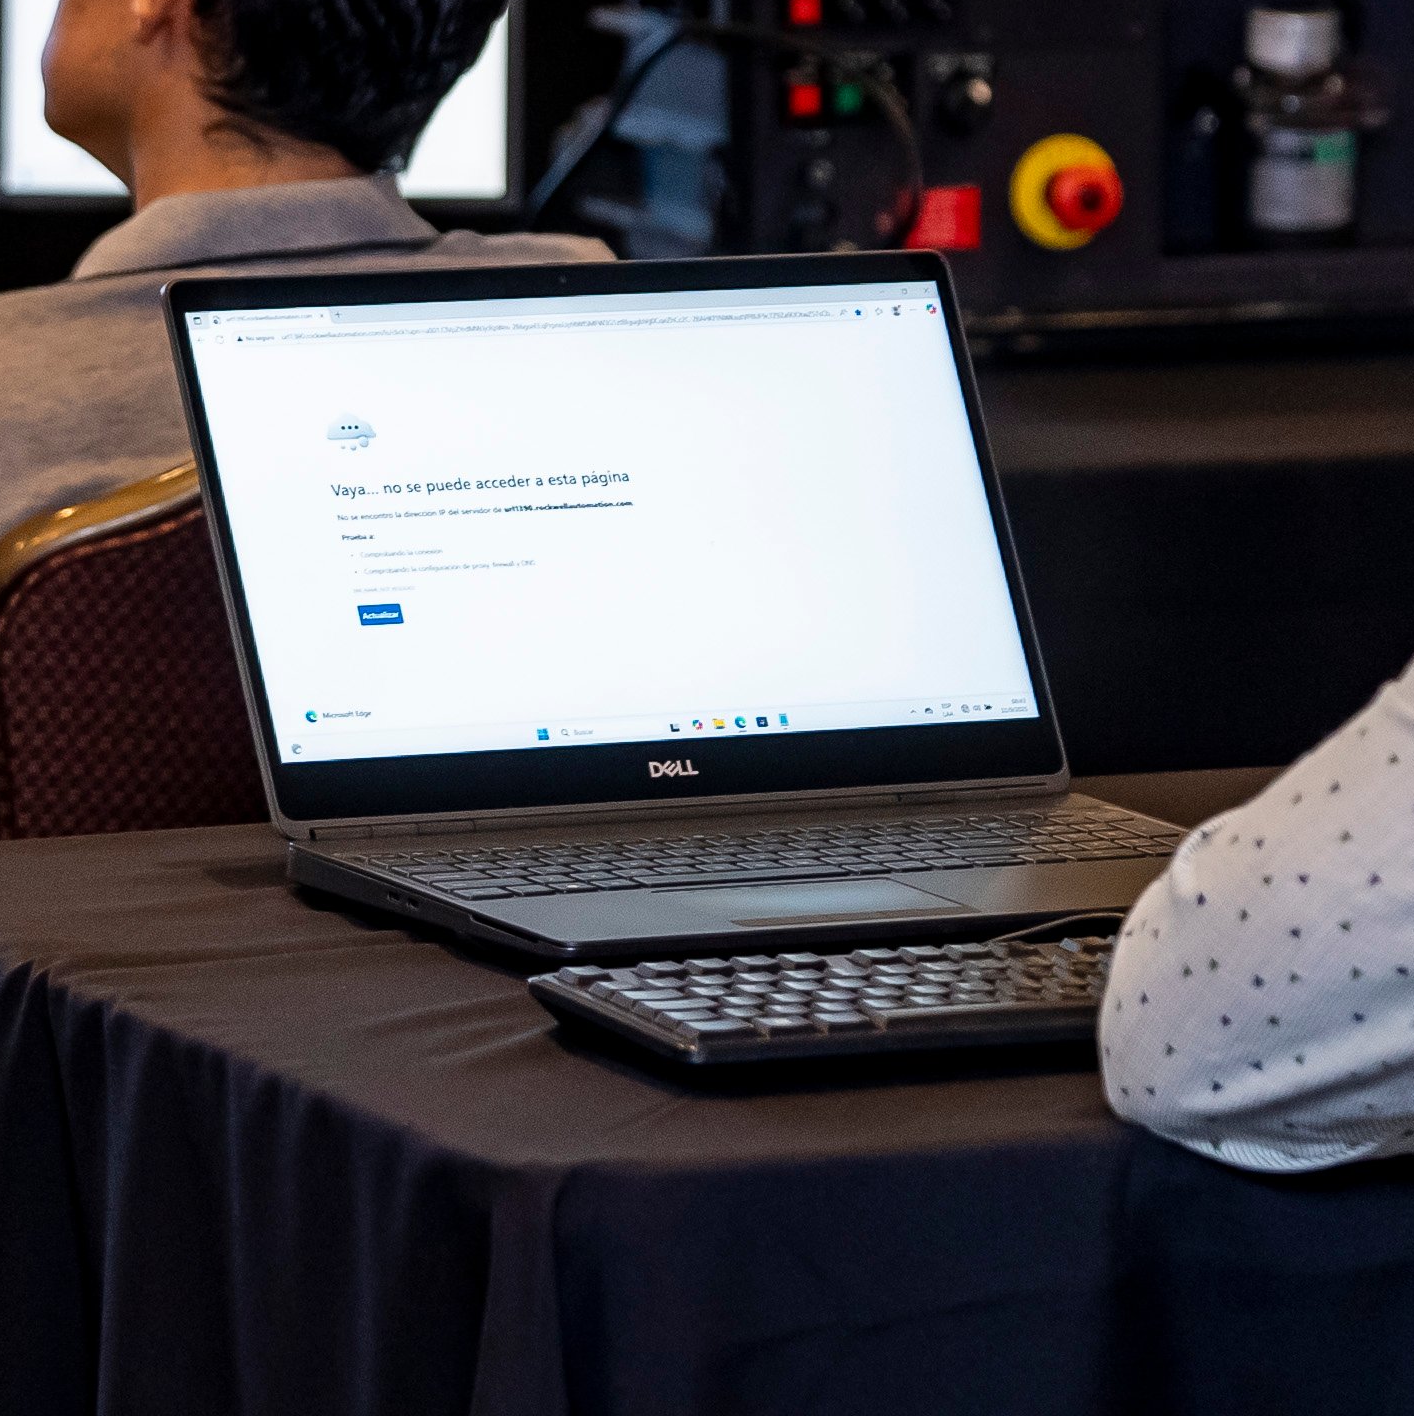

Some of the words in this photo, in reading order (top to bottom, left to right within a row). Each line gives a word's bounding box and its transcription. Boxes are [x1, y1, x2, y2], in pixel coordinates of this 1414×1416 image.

[331, 483, 380, 500] Vaya...
[383, 483, 402, 494] no
[406, 482, 422, 493] se
[426, 477, 471, 495] puede
[476, 474, 531, 490] acceder
[535, 477, 544, 487] a
[548, 473, 577, 486] esta
[581, 470, 630, 488] página
[323, 711, 353, 719] Microsoft
[649, 759, 699, 778] DELL
